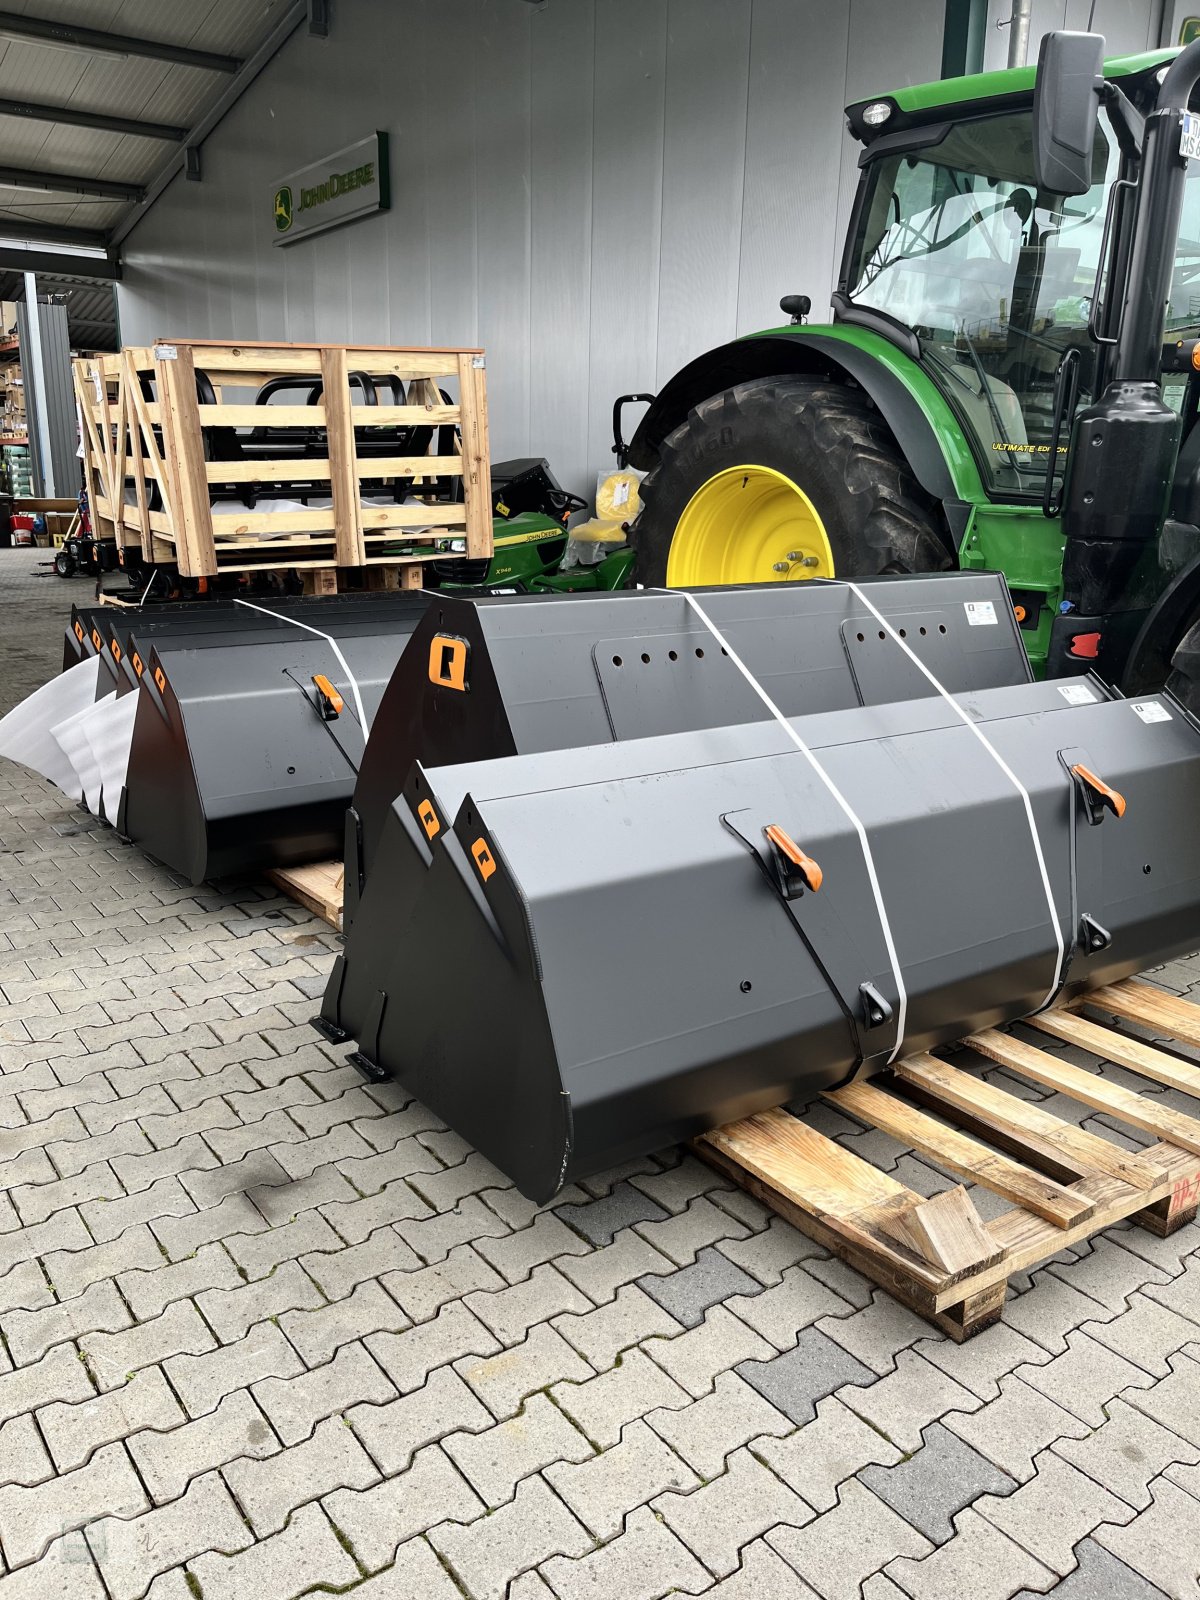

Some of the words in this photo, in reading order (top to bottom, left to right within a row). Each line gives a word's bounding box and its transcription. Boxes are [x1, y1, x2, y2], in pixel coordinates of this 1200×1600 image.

[992, 442, 1036, 453] ULTIMATE
[526, 534, 541, 542] JOHN
[541, 529, 558, 539] DEERE
